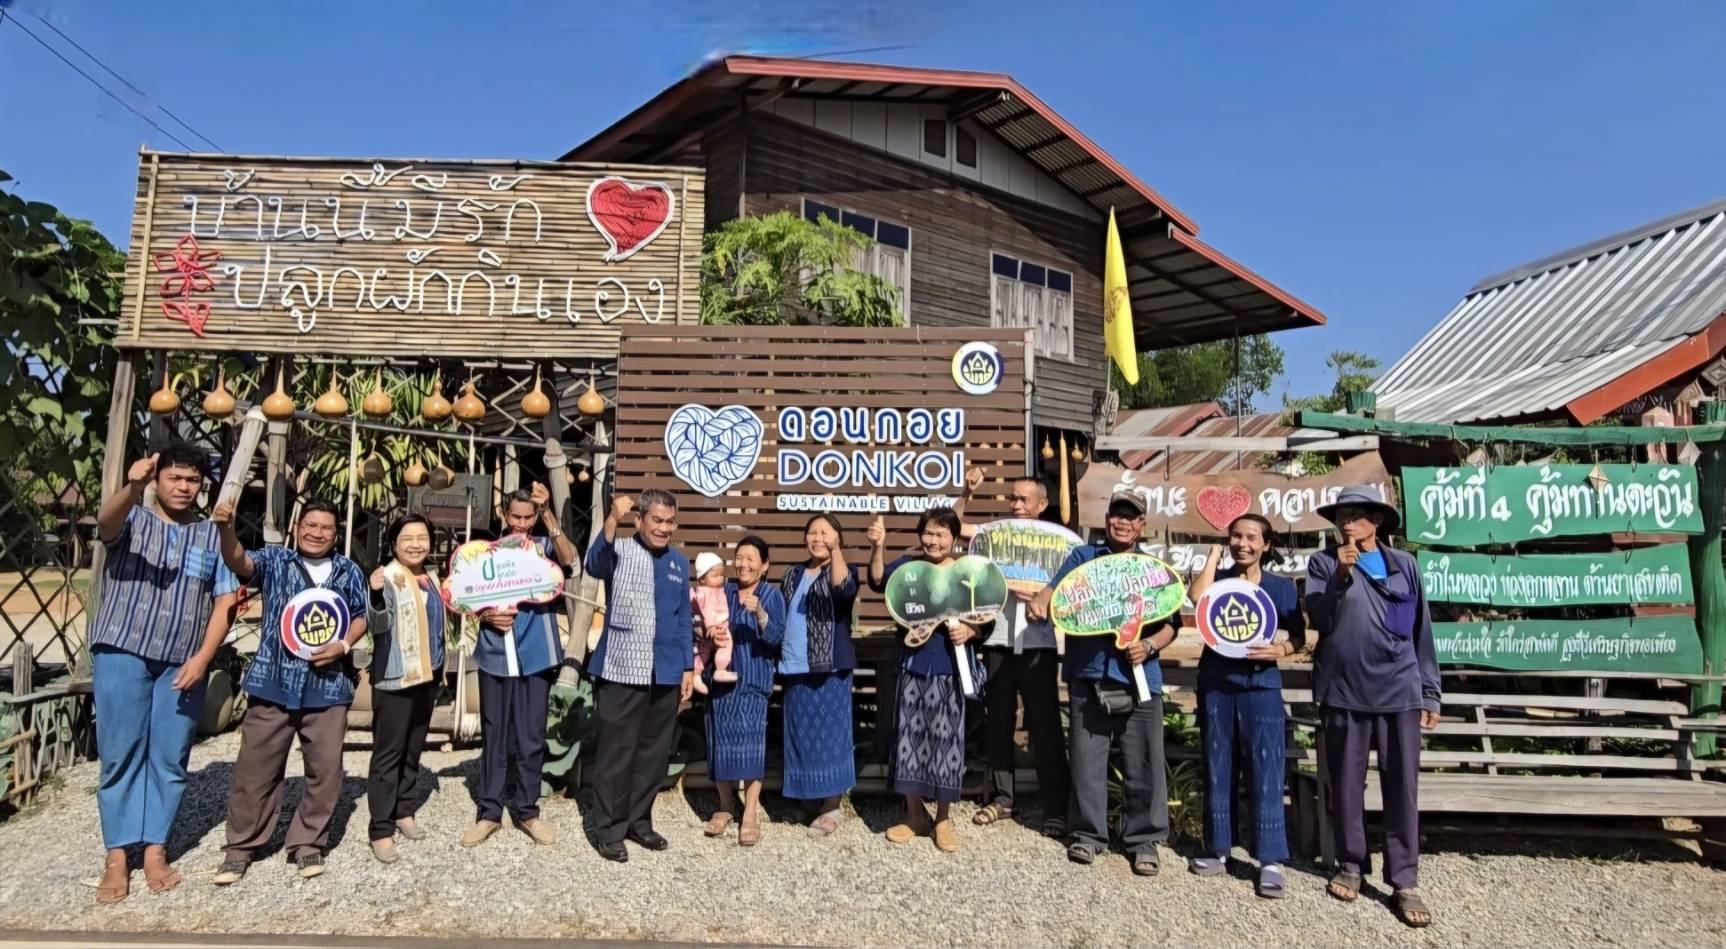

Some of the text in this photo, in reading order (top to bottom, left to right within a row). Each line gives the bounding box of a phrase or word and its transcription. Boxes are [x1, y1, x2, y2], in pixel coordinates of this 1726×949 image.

[225, 244, 664, 333] ปลูกผักกินเอง
[779, 406, 965, 443] ดอนกอย
[778, 449, 966, 488] DONKOI
[778, 495, 888, 510] SUSTAINABLE
[1491, 496, 1512, 522] 4
